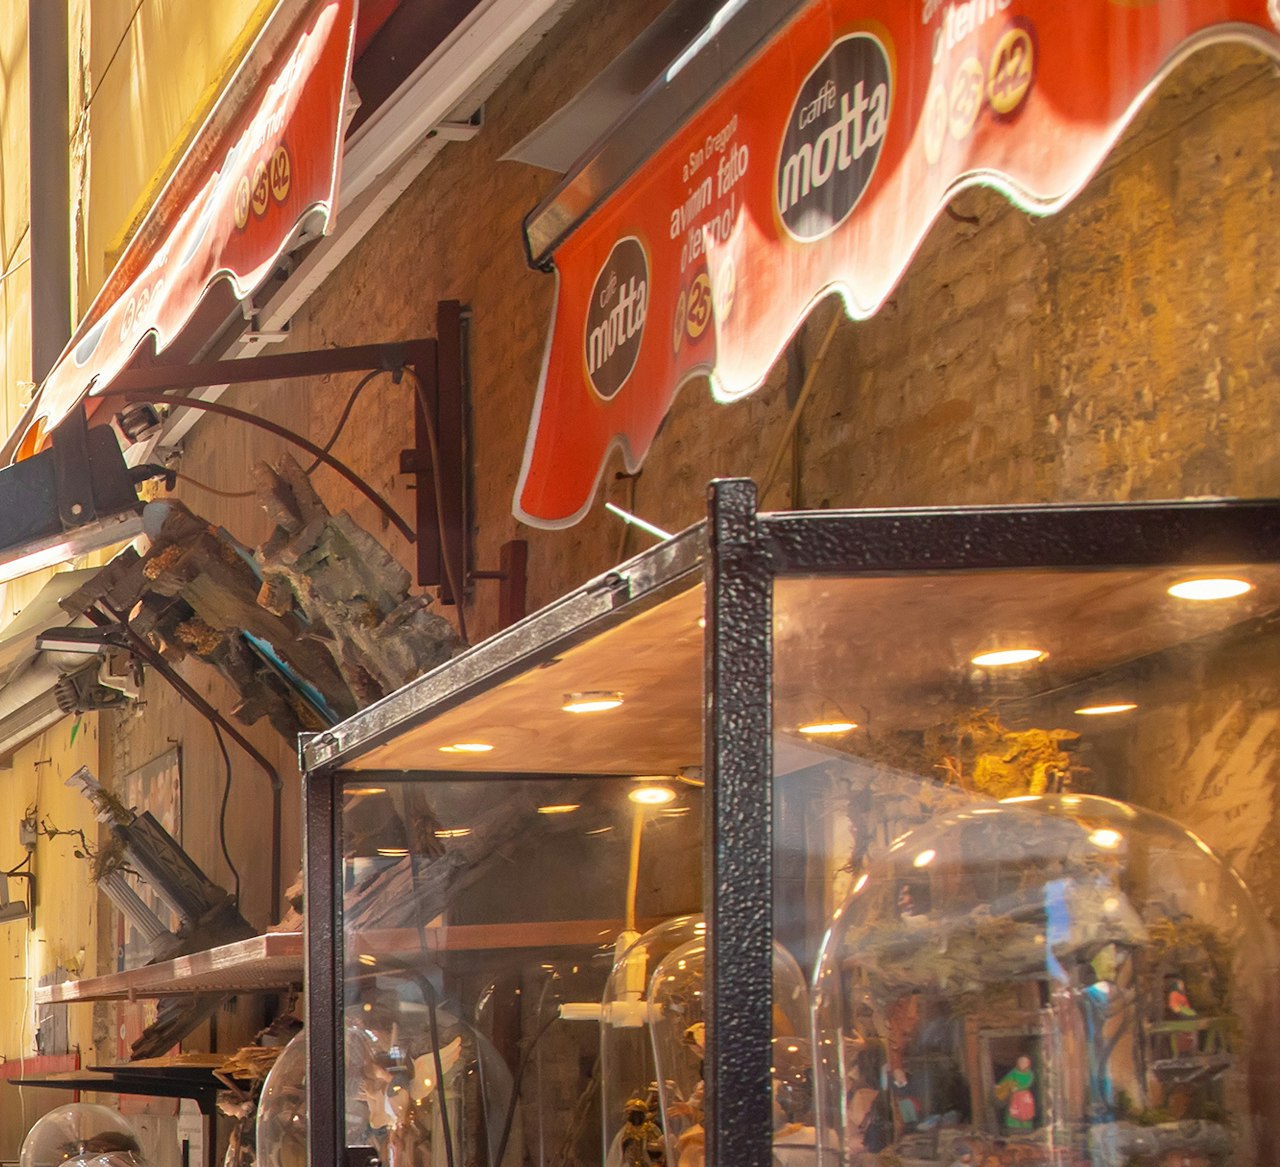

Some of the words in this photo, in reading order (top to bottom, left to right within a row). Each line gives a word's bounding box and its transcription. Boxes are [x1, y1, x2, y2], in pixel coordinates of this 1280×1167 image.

[993, 36, 1029, 98] 42
[798, 80, 837, 131] caffè
[271, 156, 289, 191] 42
[682, 163, 689, 183] a
[716, 144, 749, 199] fatto
[780, 80, 889, 216] motta
[589, 275, 647, 376] motta
